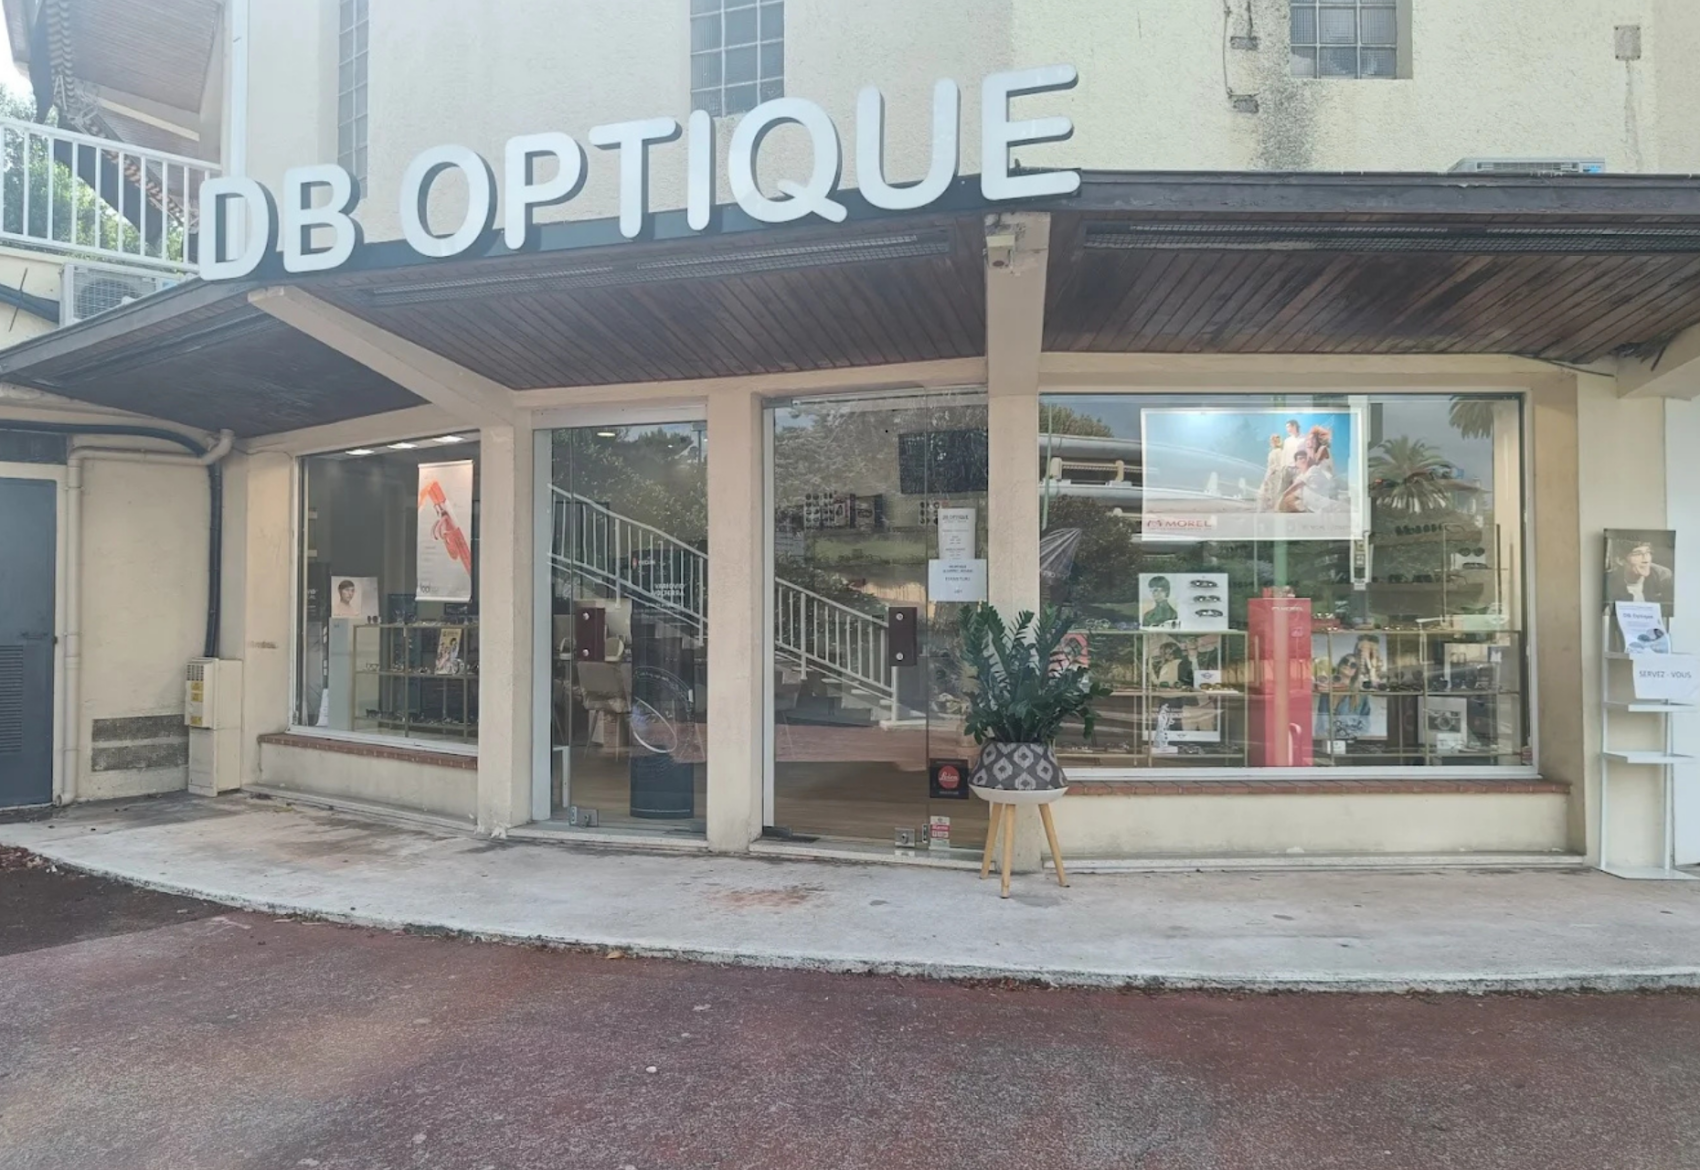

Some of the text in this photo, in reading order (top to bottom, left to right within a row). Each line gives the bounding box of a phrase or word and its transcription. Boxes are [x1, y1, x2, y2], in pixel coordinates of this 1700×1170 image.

[199, 63, 1082, 281] DB OPTIQUE
[1639, 670, 1665, 678] SERVEZ
[1670, 671, 1692, 679] VOUS
[939, 771, 959, 782] Leica
